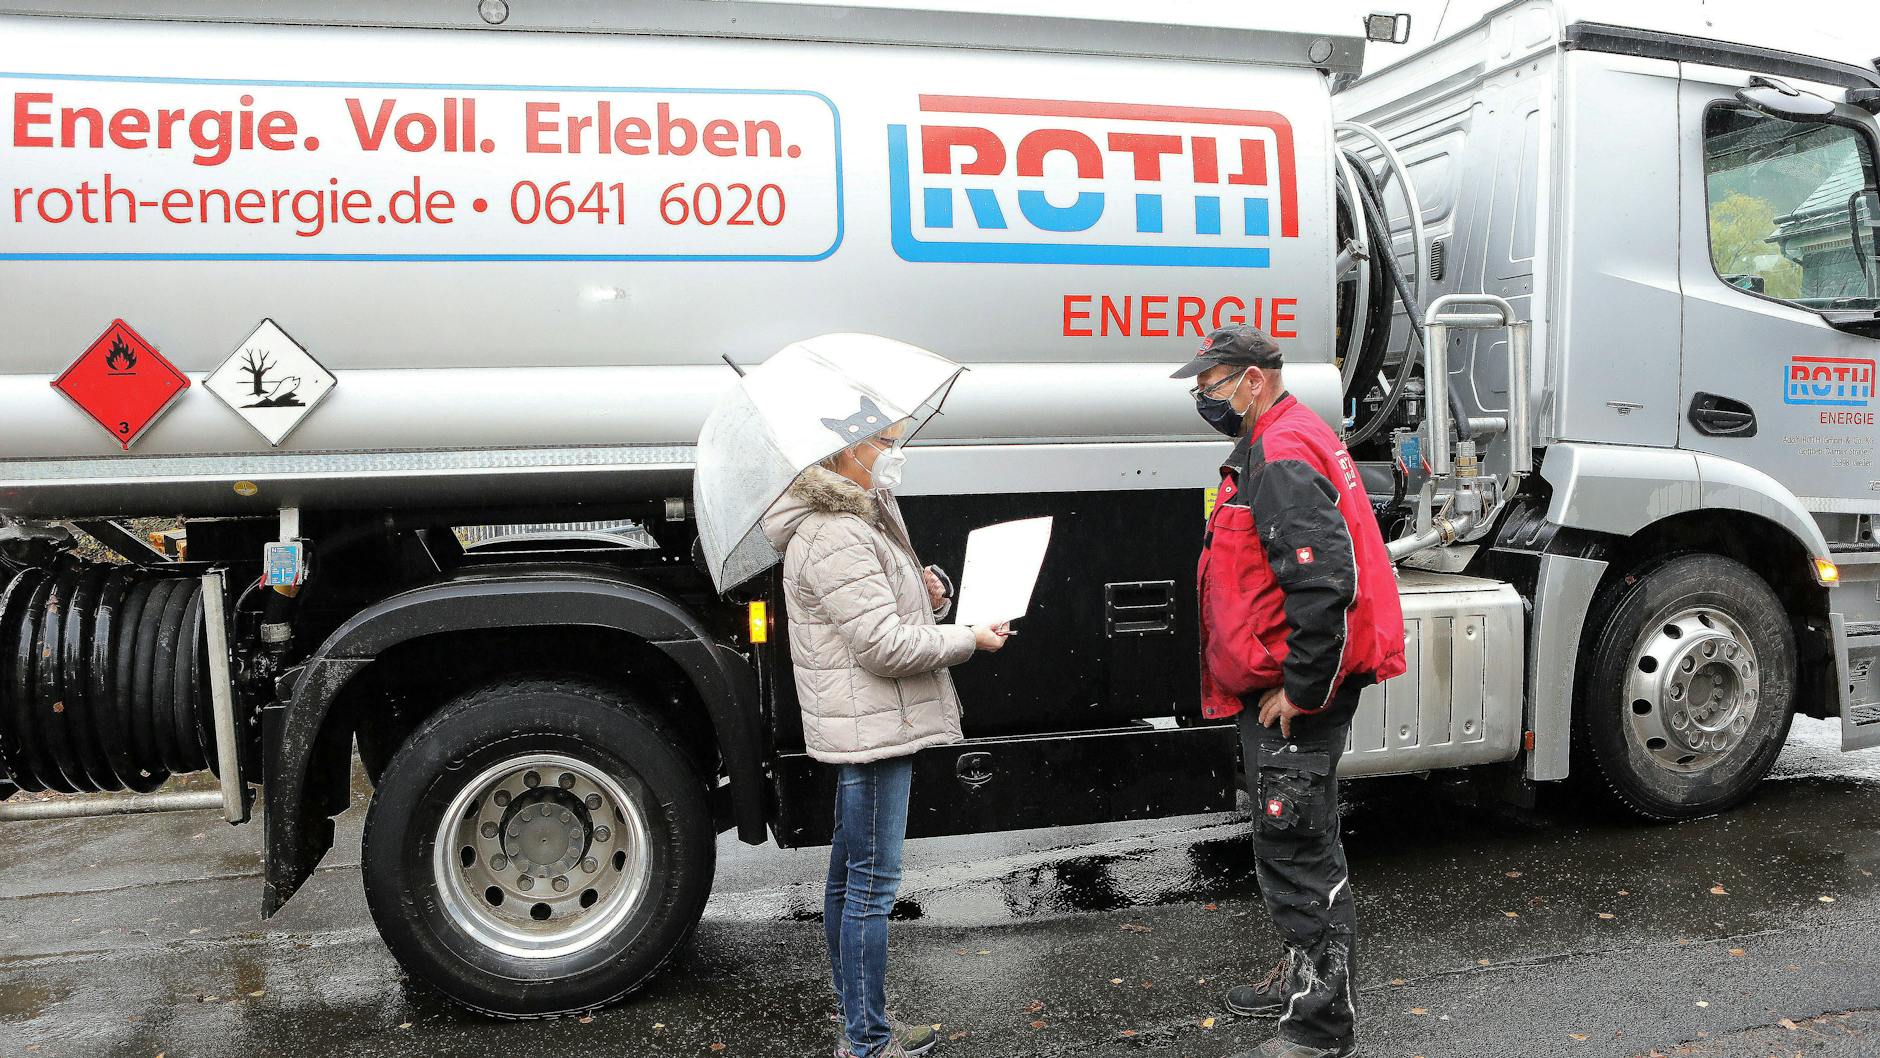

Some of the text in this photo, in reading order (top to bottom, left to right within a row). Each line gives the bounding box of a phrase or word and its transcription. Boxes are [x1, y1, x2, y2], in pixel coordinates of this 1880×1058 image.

[14, 92, 802, 166] Energie. Voll. Erleben.
[920, 124, 1270, 236] ROTH
[13, 173, 786, 237] roth-energie.de 0641 6020
[1062, 294, 1299, 338] ENERGIE
[1791, 365, 1869, 397] ROTH
[119, 421, 129, 434] 3
[1820, 411, 1874, 425] ENERGIE
